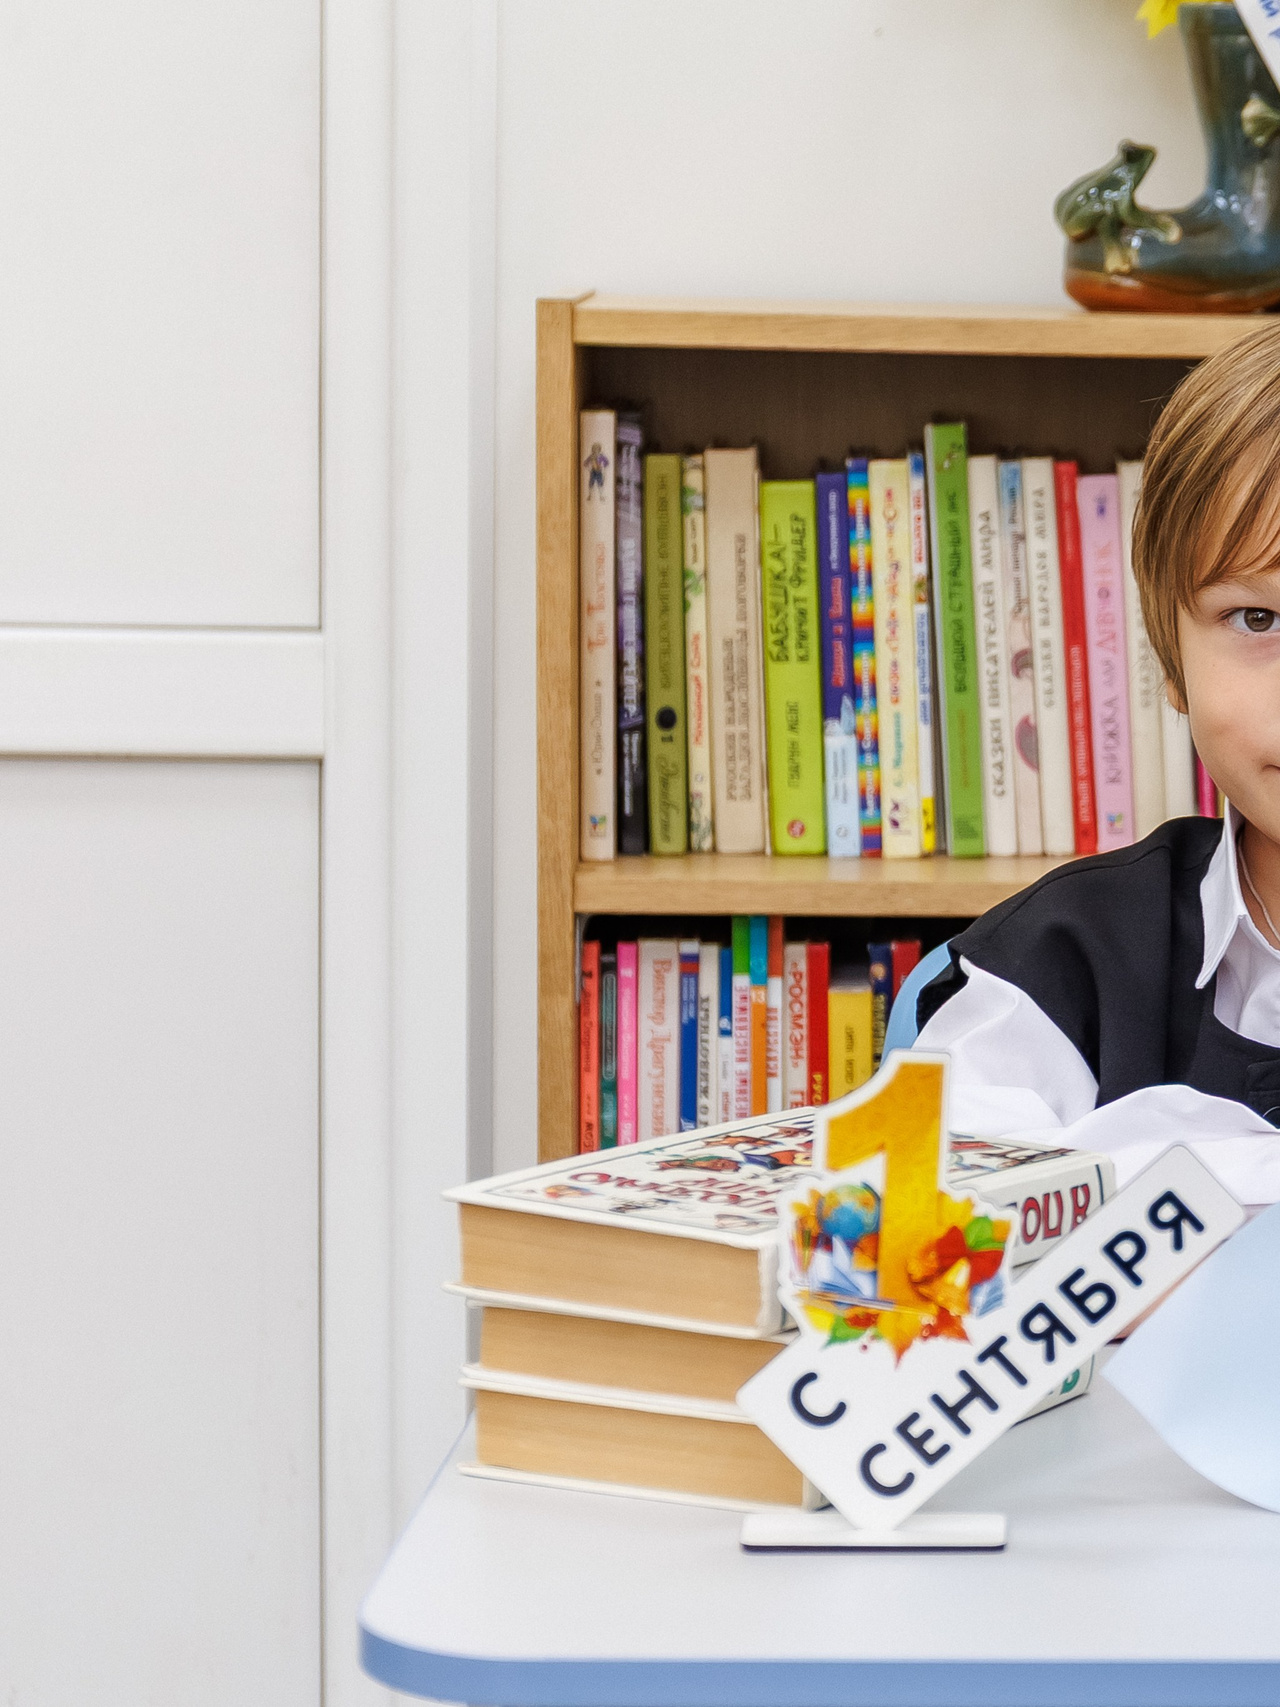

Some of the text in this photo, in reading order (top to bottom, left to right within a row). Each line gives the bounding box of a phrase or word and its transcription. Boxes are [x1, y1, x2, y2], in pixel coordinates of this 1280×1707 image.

[1032, 486, 1055, 708] СКАЗКИ НАРОДОВ МИРА
[978, 510, 1007, 799] СКАЗКИ ПИСАТЕЛЕЙ МИРА
[1104, 697, 1122, 785] КНИЖКА
[646, 958, 672, 1025] Виктор
[699, 994, 710, 1099] ЖИВОТНЫХ
[858, 1189, 1206, 1498] СЕНТЯБРЯ
[788, 1371, 848, 1427] С
